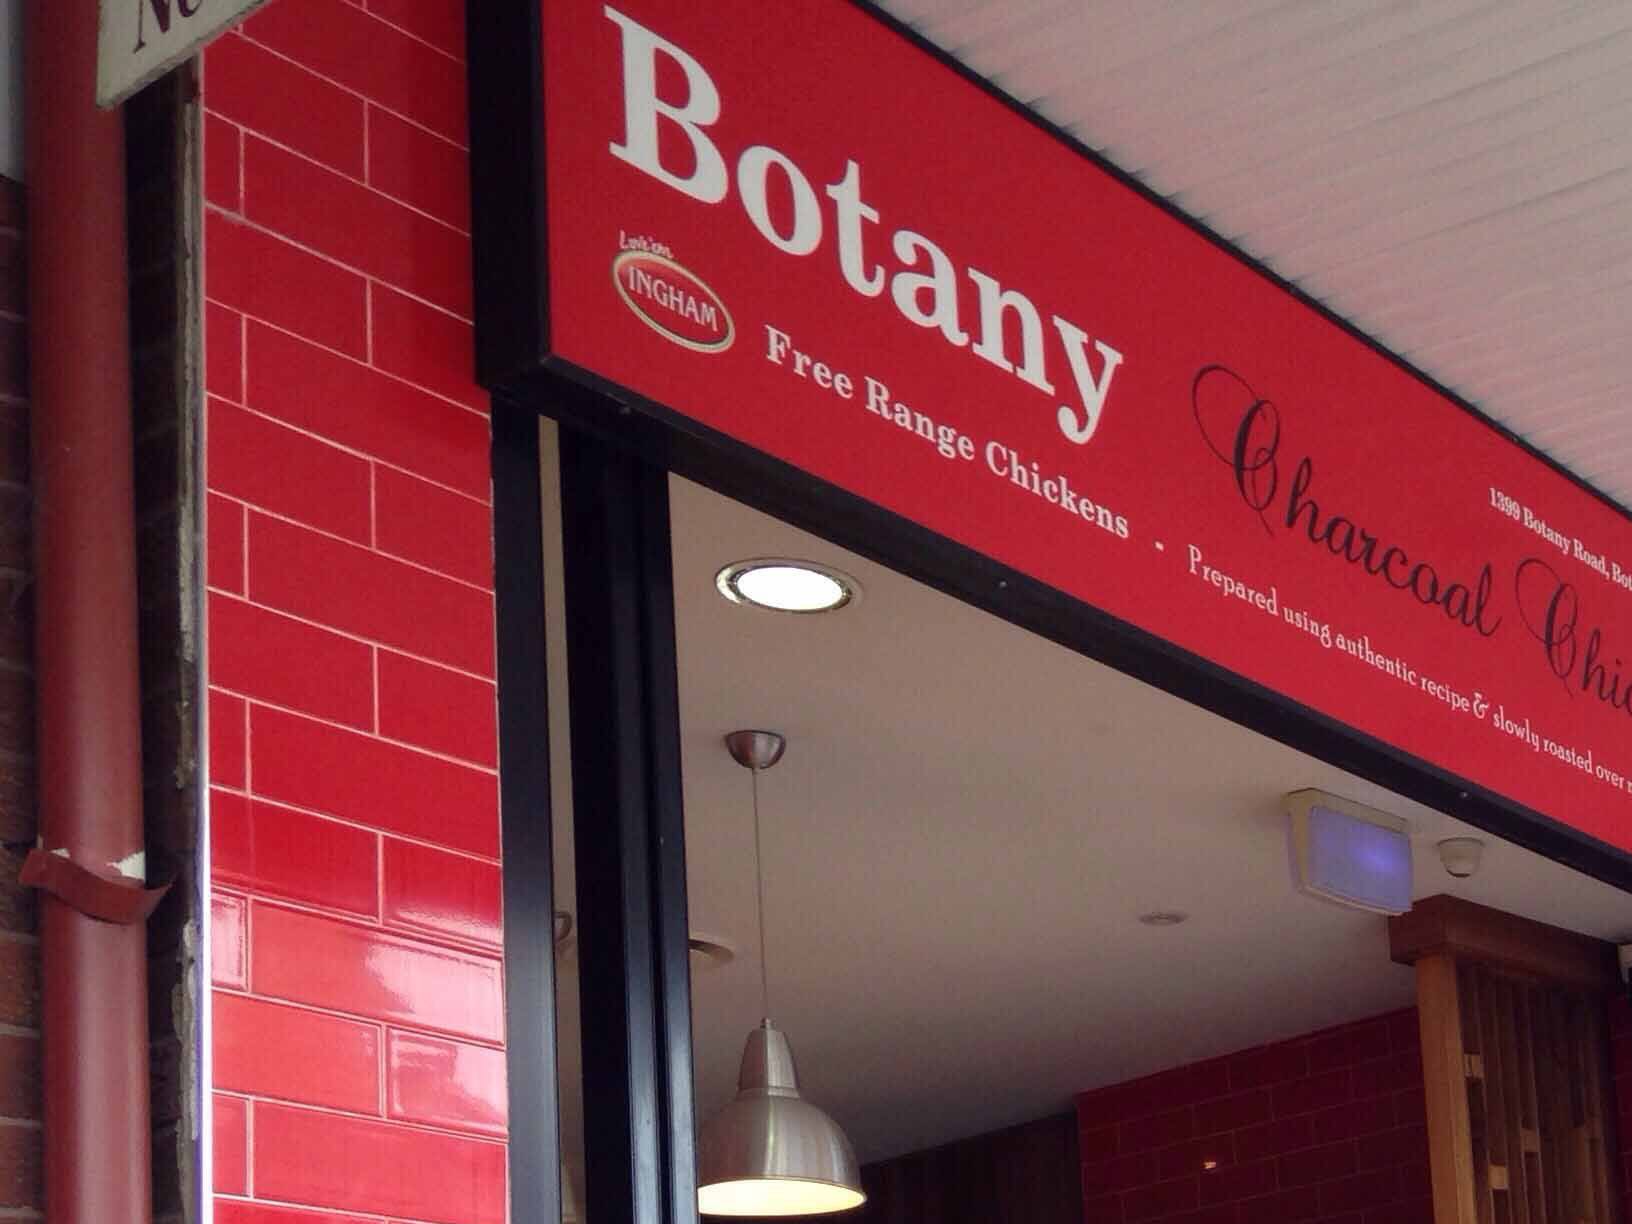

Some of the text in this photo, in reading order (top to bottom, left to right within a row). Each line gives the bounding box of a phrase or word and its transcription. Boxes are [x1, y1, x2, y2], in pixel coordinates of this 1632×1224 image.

[604, 6, 1123, 444] Botany
[627, 265, 719, 332] INGHAM
[764, 324, 854, 400] Free
[864, 375, 976, 460] Range
[985, 440, 1130, 539] Chickens
[1187, 543, 1279, 616] Prepared
[1283, 604, 1332, 649] using
[1335, 632, 1417, 687] authentic
[1420, 675, 1471, 713] recipe
[1472, 692, 1489, 720] &
[1493, 705, 1541, 751] slowly
[1543, 737, 1594, 775] roasted
[1596, 763, 1626, 791] over
[1191, 363, 1503, 638] Charcoal
[1489, 486, 1522, 521] 1399
[1522, 505, 1572, 556] Botany
[1572, 538, 1611, 581] Road,
